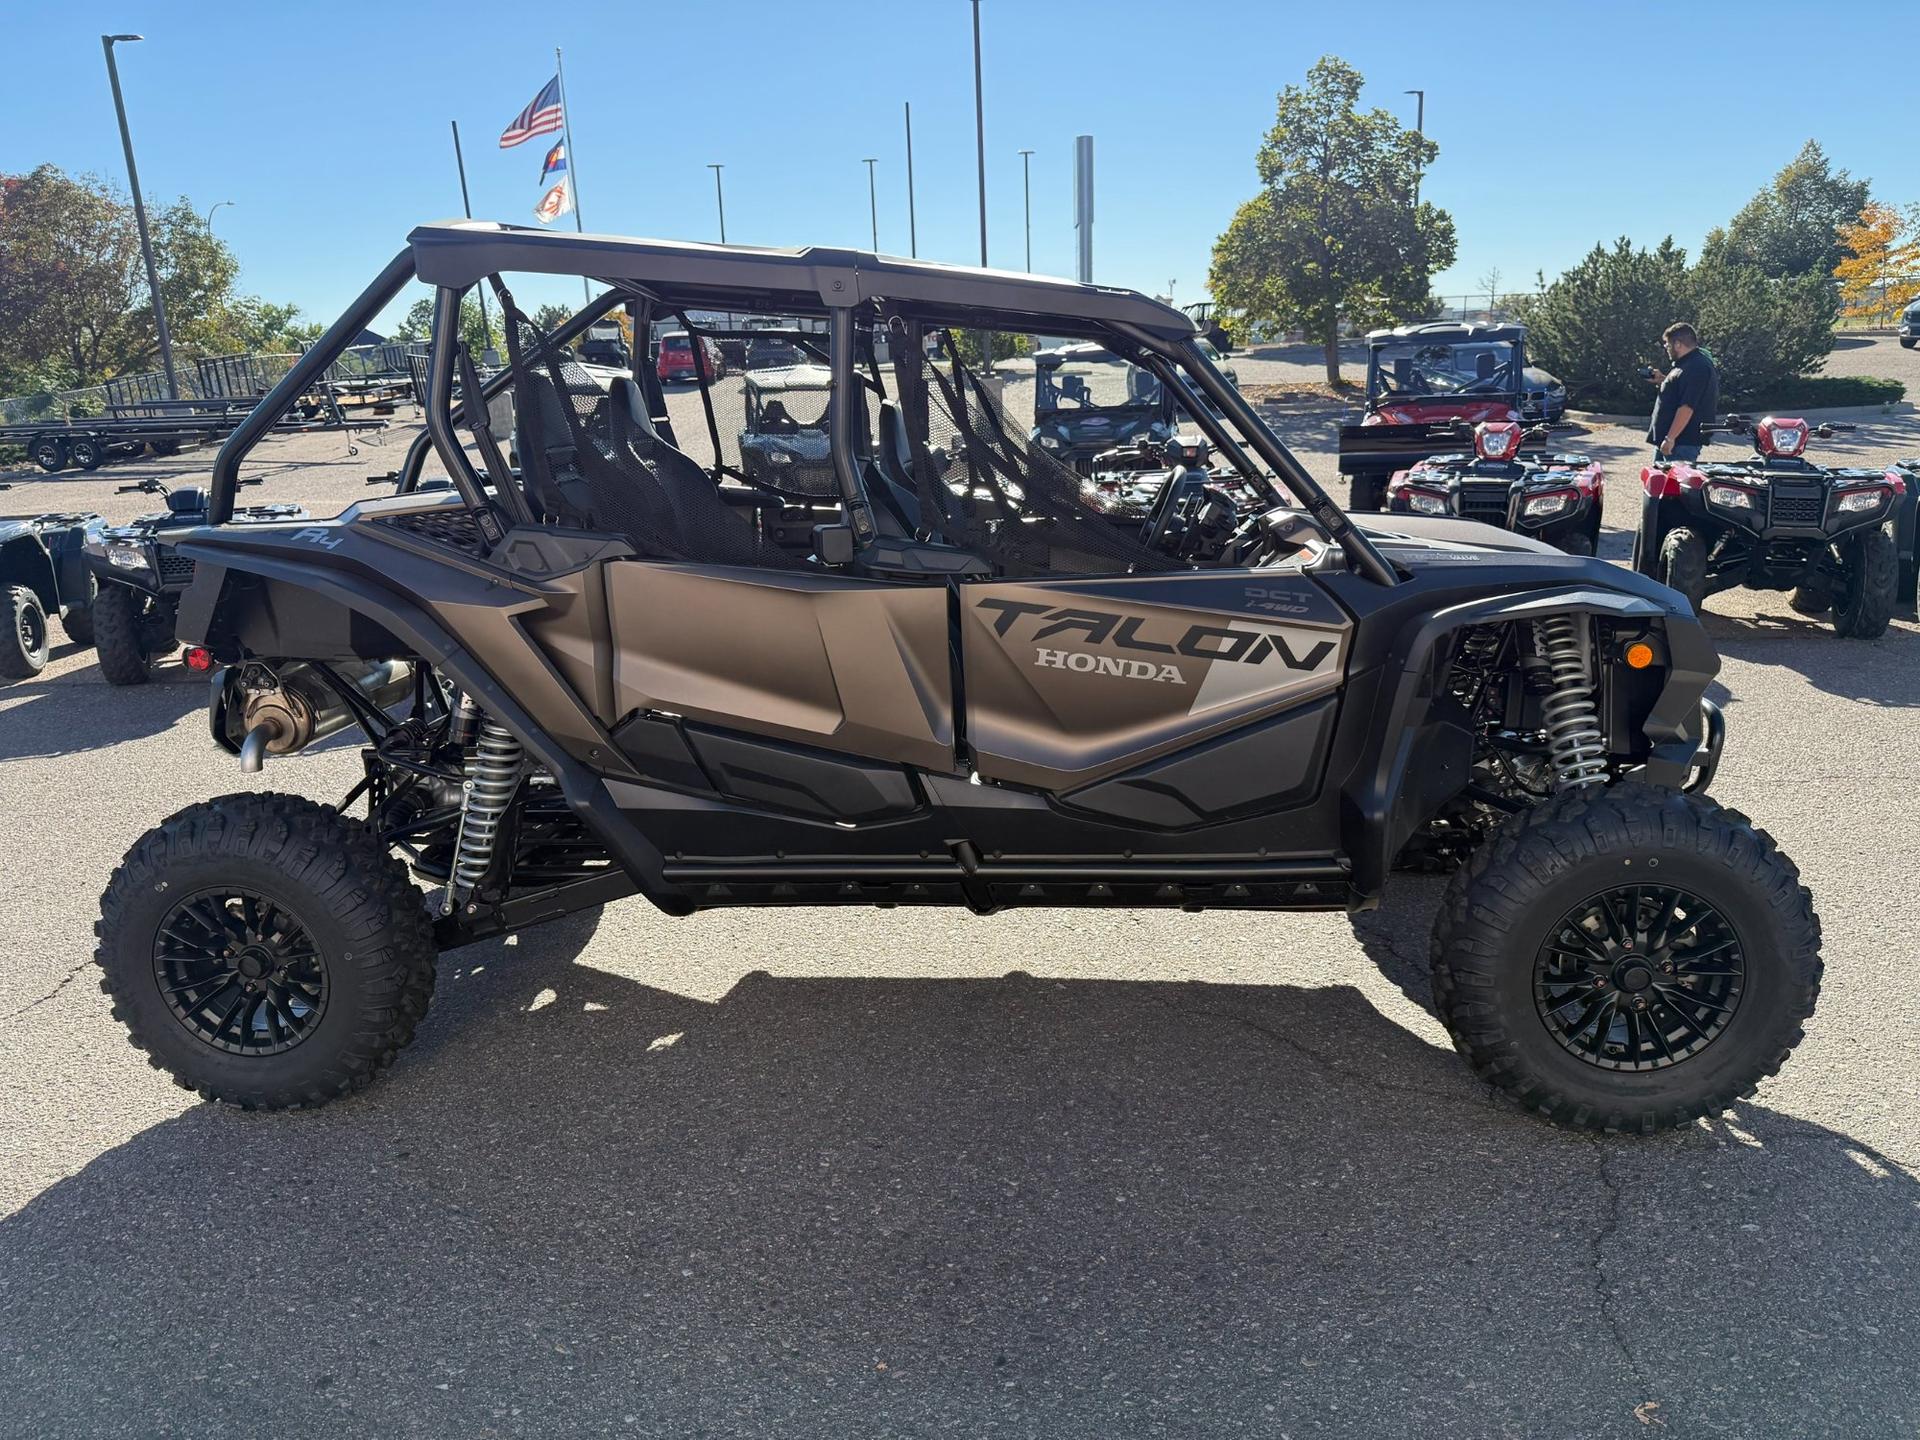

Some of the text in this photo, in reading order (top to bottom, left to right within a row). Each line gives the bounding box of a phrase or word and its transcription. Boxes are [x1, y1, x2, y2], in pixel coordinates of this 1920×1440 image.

[1244, 587, 1313, 603] DCT
[977, 598, 1337, 671] TALON
[1034, 647, 1187, 685] HONDA
